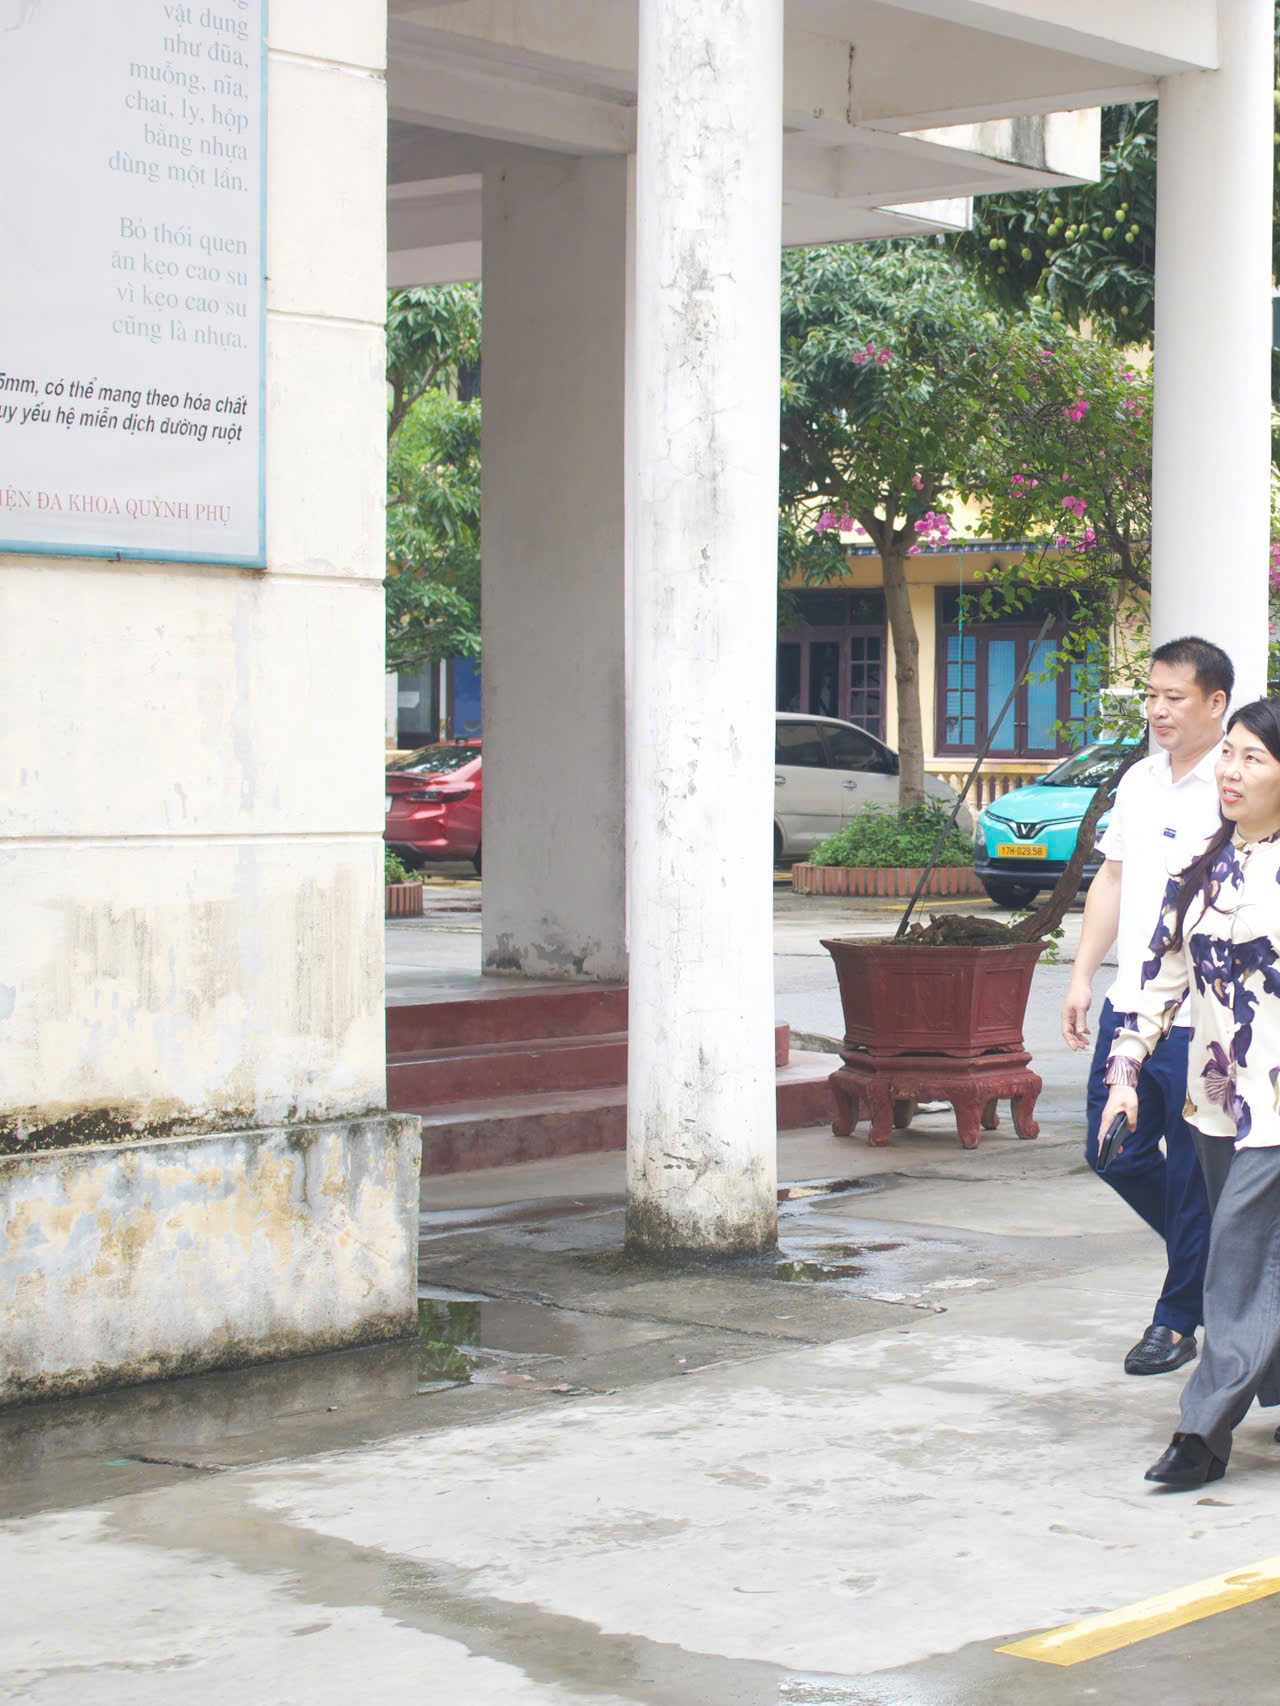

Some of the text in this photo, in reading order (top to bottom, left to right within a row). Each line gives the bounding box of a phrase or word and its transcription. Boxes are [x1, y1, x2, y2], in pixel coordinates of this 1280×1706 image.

[163, 3, 249, 40] vật dụng
[163, 33, 249, 69] như đũa,
[129, 61, 249, 101] muỗng, nĩa,
[124, 90, 249, 134] chai, ly, hộp
[144, 122, 248, 164] bằng nhựa
[108, 150, 248, 192] dùng một lần.
[120, 216, 247, 256] Bỏ thói quen
[111, 250, 248, 286] ăn kẹo cao su
[116, 281, 247, 318] vì kẹo cao su
[112, 314, 248, 352] cũng là nhựa.
[45, 378, 65, 396] có
[69, 376, 97, 399] thể
[98, 387, 142, 408] mang
[146, 388, 179, 408] theo
[183, 392, 211, 411] hóa
[215, 395, 248, 415] chất
[20, 401, 51, 425] yếu
[56, 406, 75, 430] hệ
[80, 406, 118, 429] miễn
[122, 413, 155, 436] dịch
[160, 417, 208, 441] đường
[211, 423, 242, 445] ruột
[38, 491, 62, 511] ĐA
[68, 494, 121, 514] KHOA
[126, 496, 189, 520] QUỲNH
[196, 503, 231, 527] PHỤ
